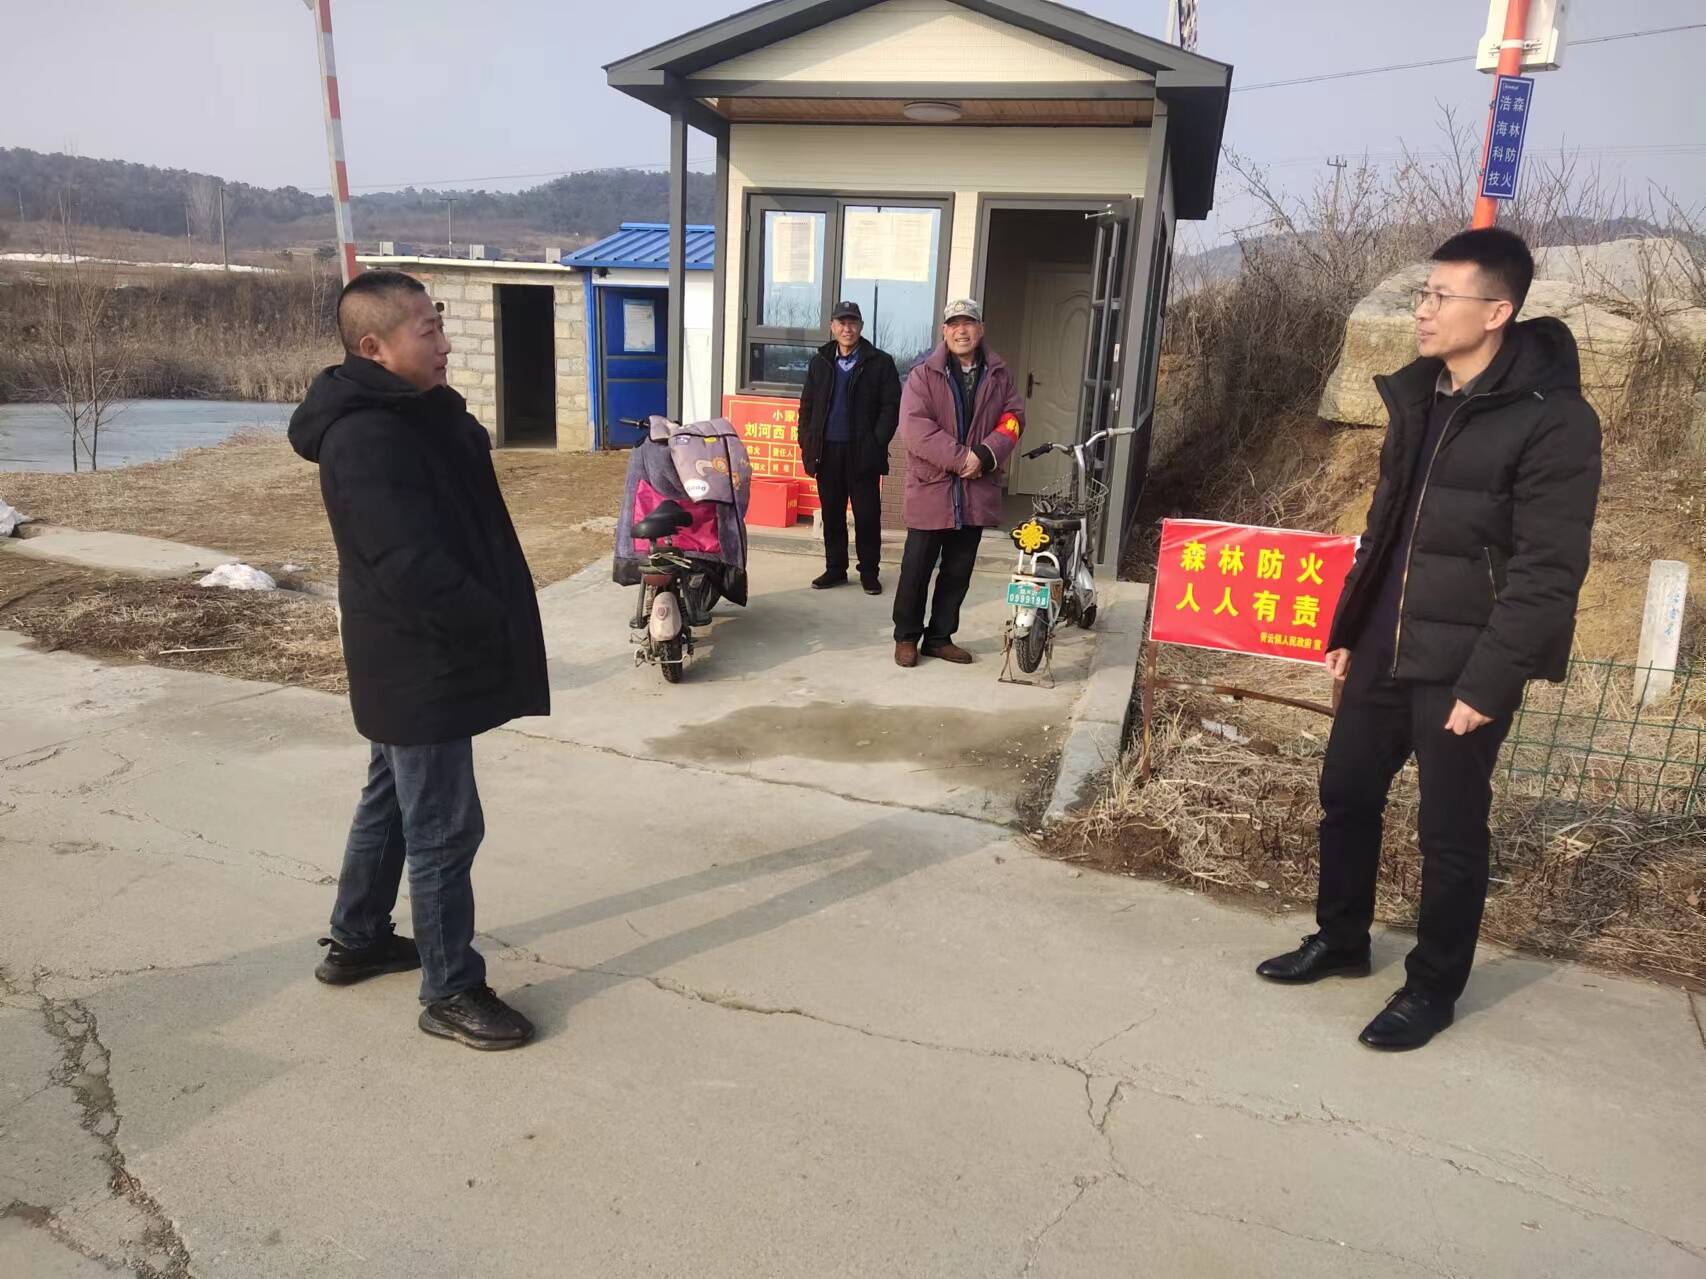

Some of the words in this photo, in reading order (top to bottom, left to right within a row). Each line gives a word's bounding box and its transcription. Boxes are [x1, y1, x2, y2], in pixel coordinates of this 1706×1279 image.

[1487, 95, 1512, 187] 浩海科技
[1499, 96, 1525, 188] 森林防火
[744, 422, 785, 440] 刘河西
[1179, 539, 1324, 585] 森林防火
[1175, 582, 1321, 628] 人人有责
